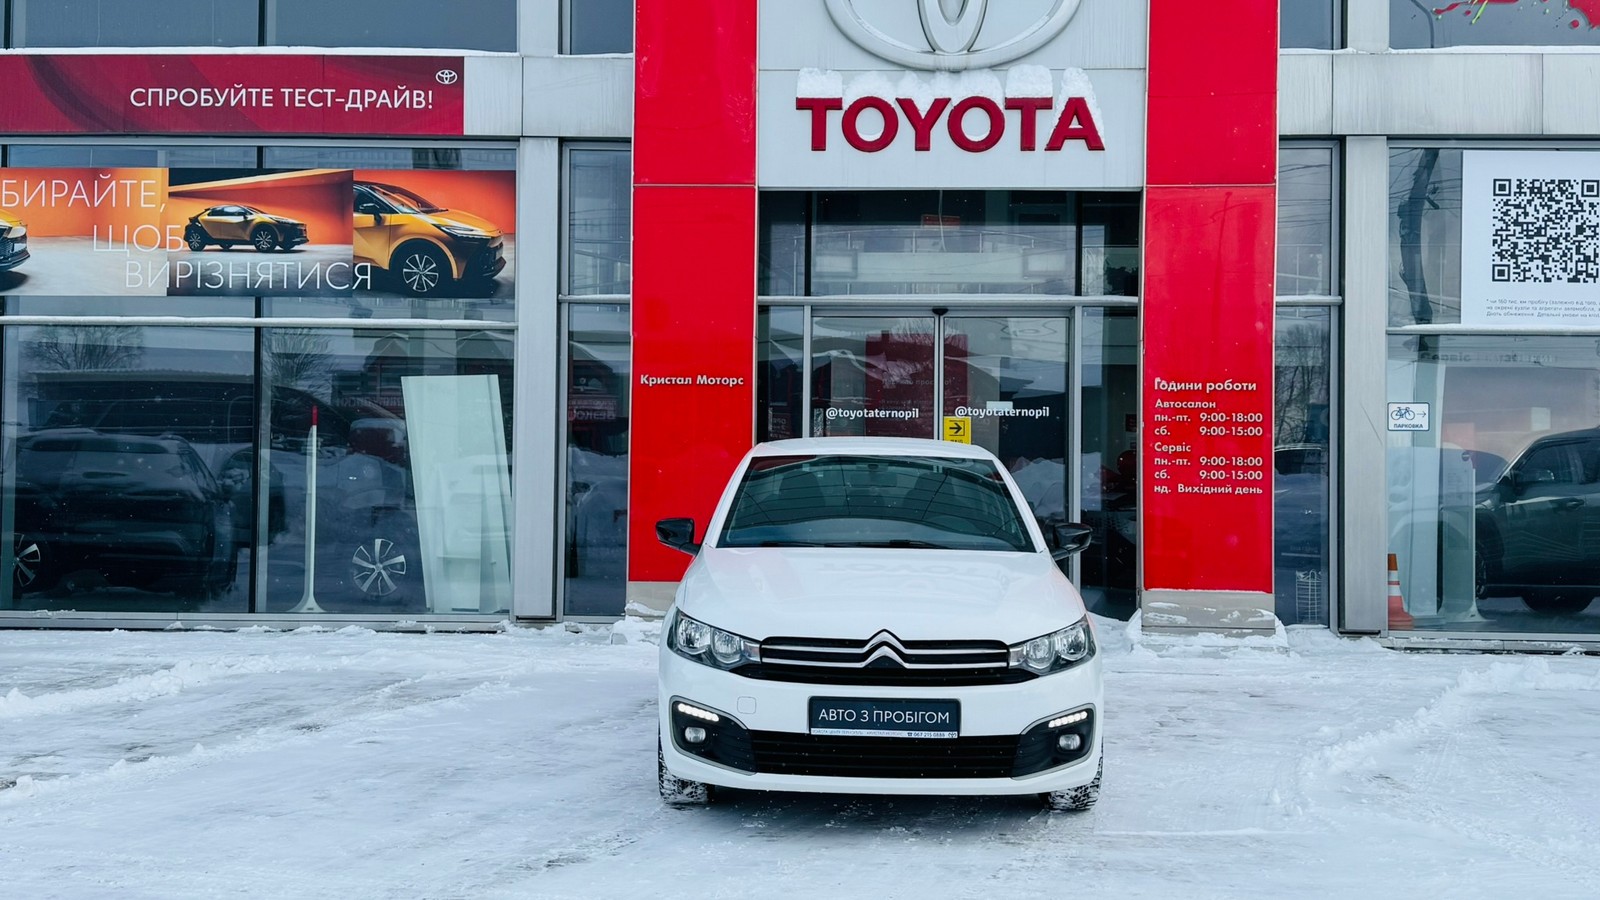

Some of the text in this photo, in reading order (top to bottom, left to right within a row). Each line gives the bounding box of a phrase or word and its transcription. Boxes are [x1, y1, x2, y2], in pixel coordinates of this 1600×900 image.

[130, 83, 434, 111] СПРОБУЙТЕ ТЕСТ-ДРАЙВ!
[795, 95, 1106, 153] TOYOTA
[2, 173, 167, 213] БИРАЙТЕ,
[92, 224, 184, 259] ЩОБ
[125, 260, 372, 291] ВИРІЗНЯТИСЯ
[640, 374, 744, 387] Кристал Моторс
[1154, 377, 1257, 394] Години роботи
[1155, 399, 1216, 409] Автосалон
[825, 407, 919, 421] @toyotaternopil
[954, 405, 1050, 420] @toyotaternopil
[1154, 414, 1191, 422] пн.-пт.
[1154, 425, 1171, 435] сб.
[1154, 442, 1192, 454] Сервіс
[1154, 457, 1191, 466] пн.-пт.
[1154, 469, 1171, 479] сб.
[1154, 483, 1263, 495] нд. Вихідний день
[818, 708, 949, 724] АВТО З ПРОБІГОМ
